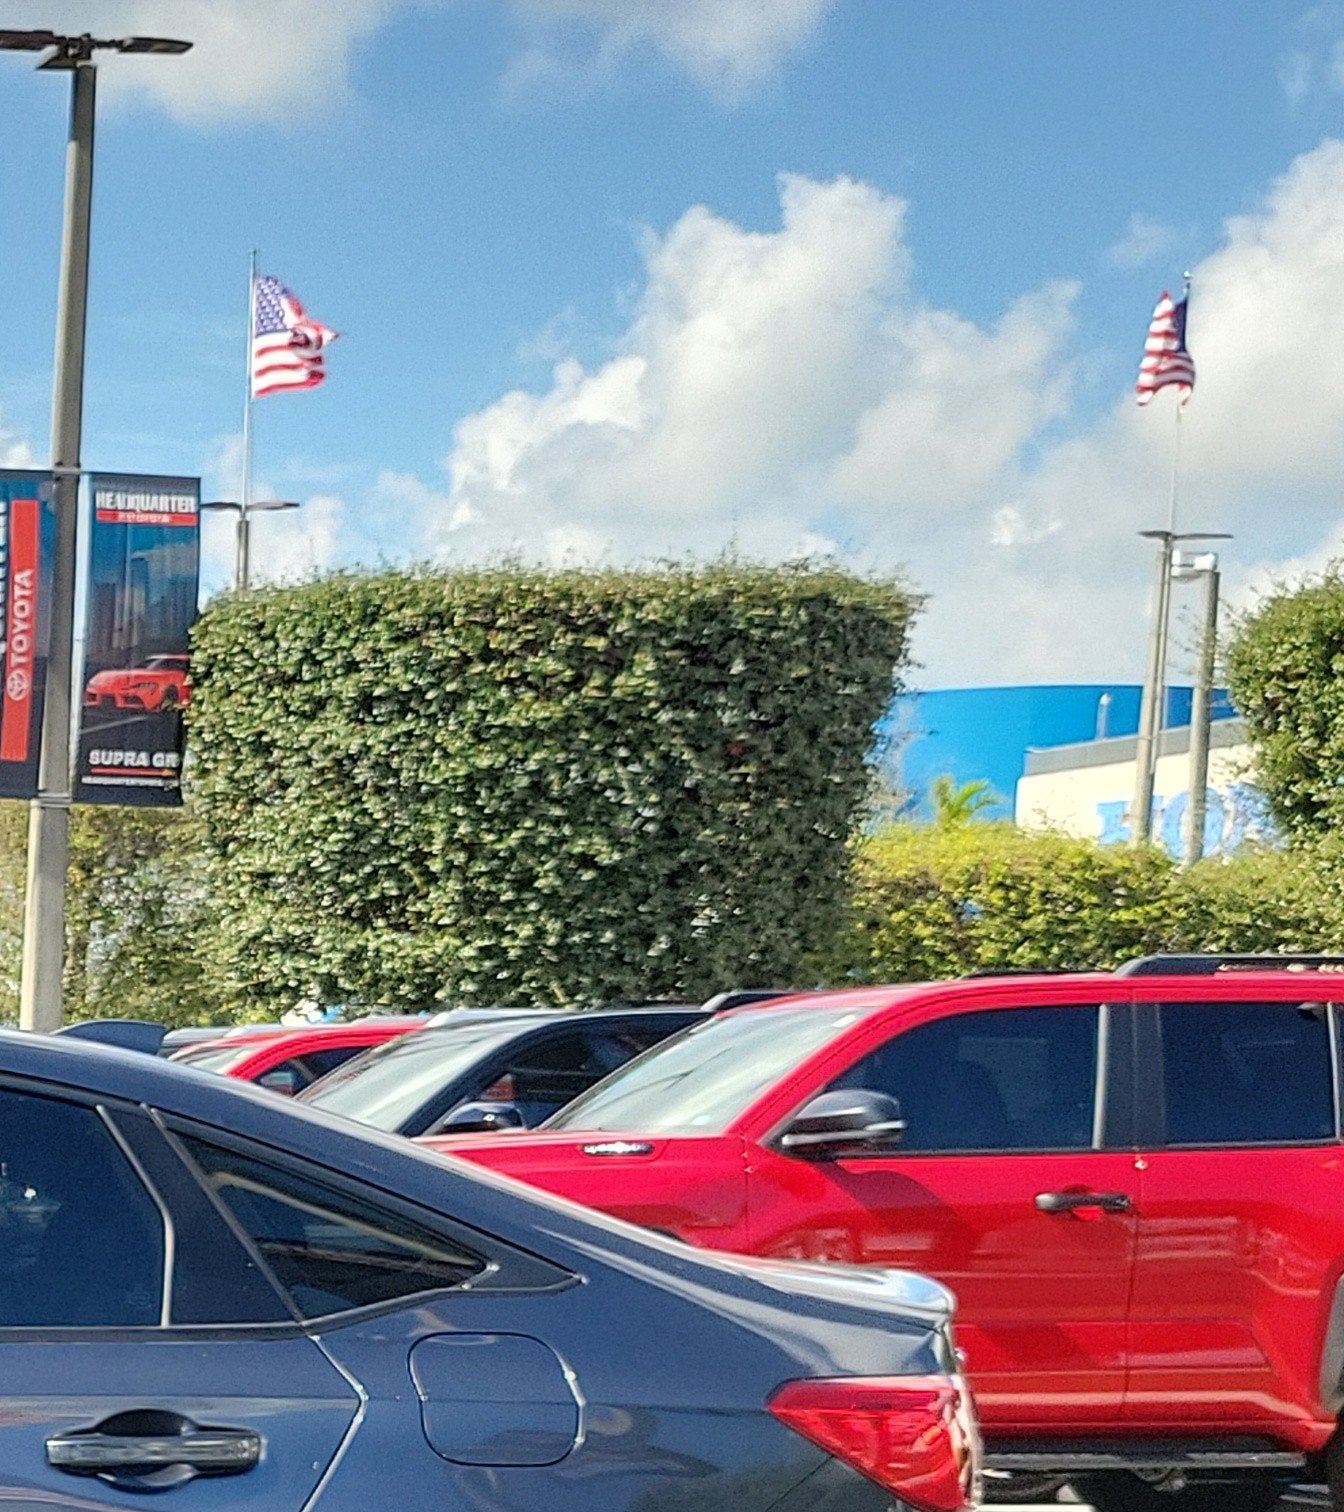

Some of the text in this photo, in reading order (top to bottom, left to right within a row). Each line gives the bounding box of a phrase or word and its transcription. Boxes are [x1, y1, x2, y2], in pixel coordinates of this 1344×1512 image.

[96, 491, 196, 513] HEADQUARTER
[11, 568, 34, 668] TOYOTA
[89, 749, 150, 767] SUPRA
